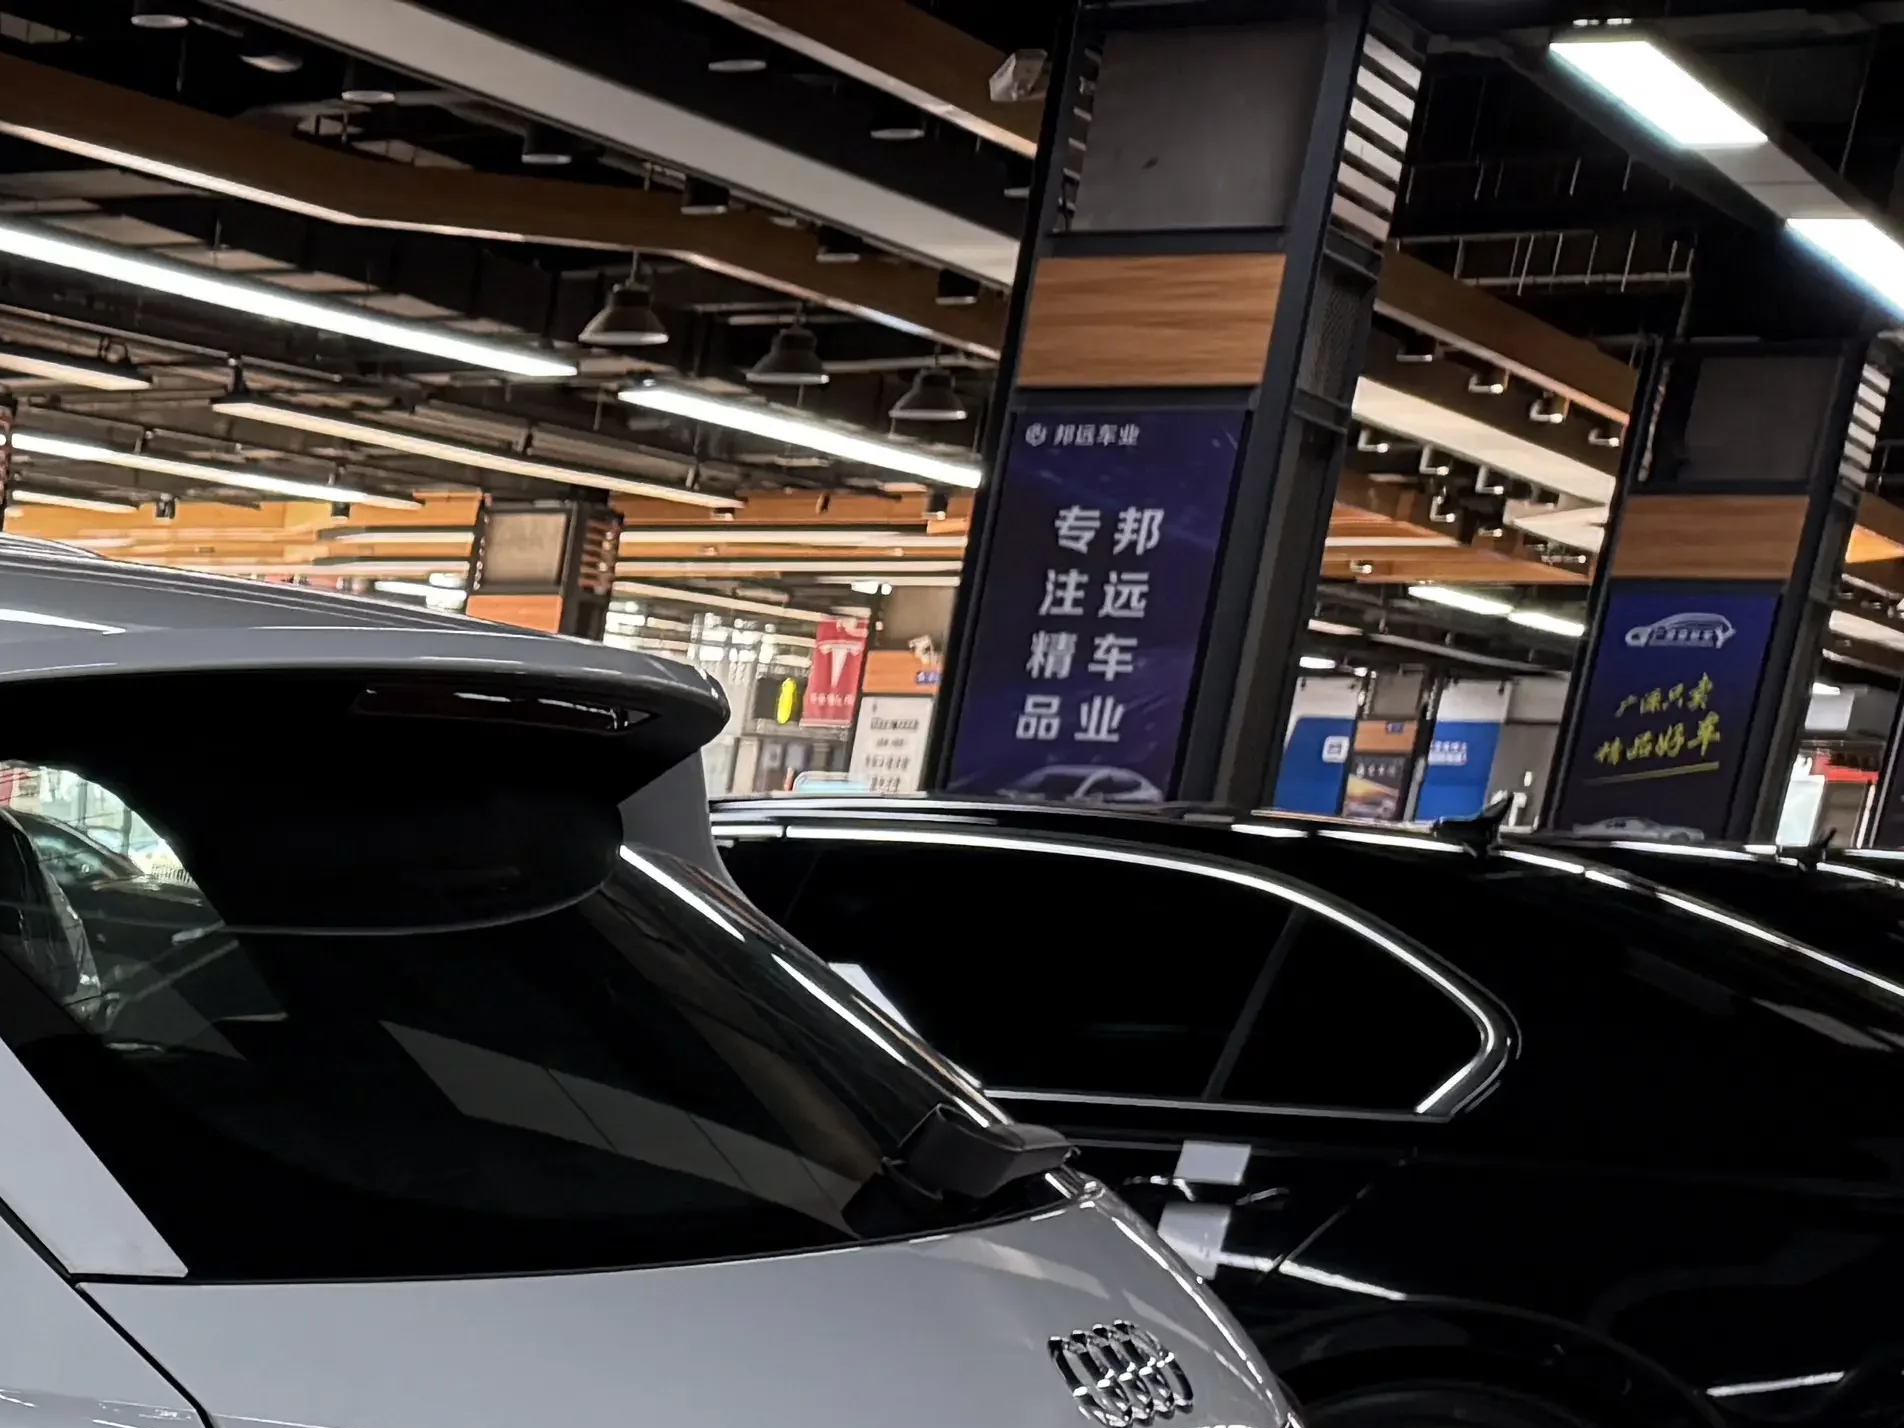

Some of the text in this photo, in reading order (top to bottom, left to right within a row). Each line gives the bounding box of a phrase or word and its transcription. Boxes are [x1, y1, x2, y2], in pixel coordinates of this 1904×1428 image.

[1052, 423, 1141, 447] 邦远车业
[1015, 504, 1102, 741] 专注精品
[1073, 505, 1165, 743] 邦远车业
